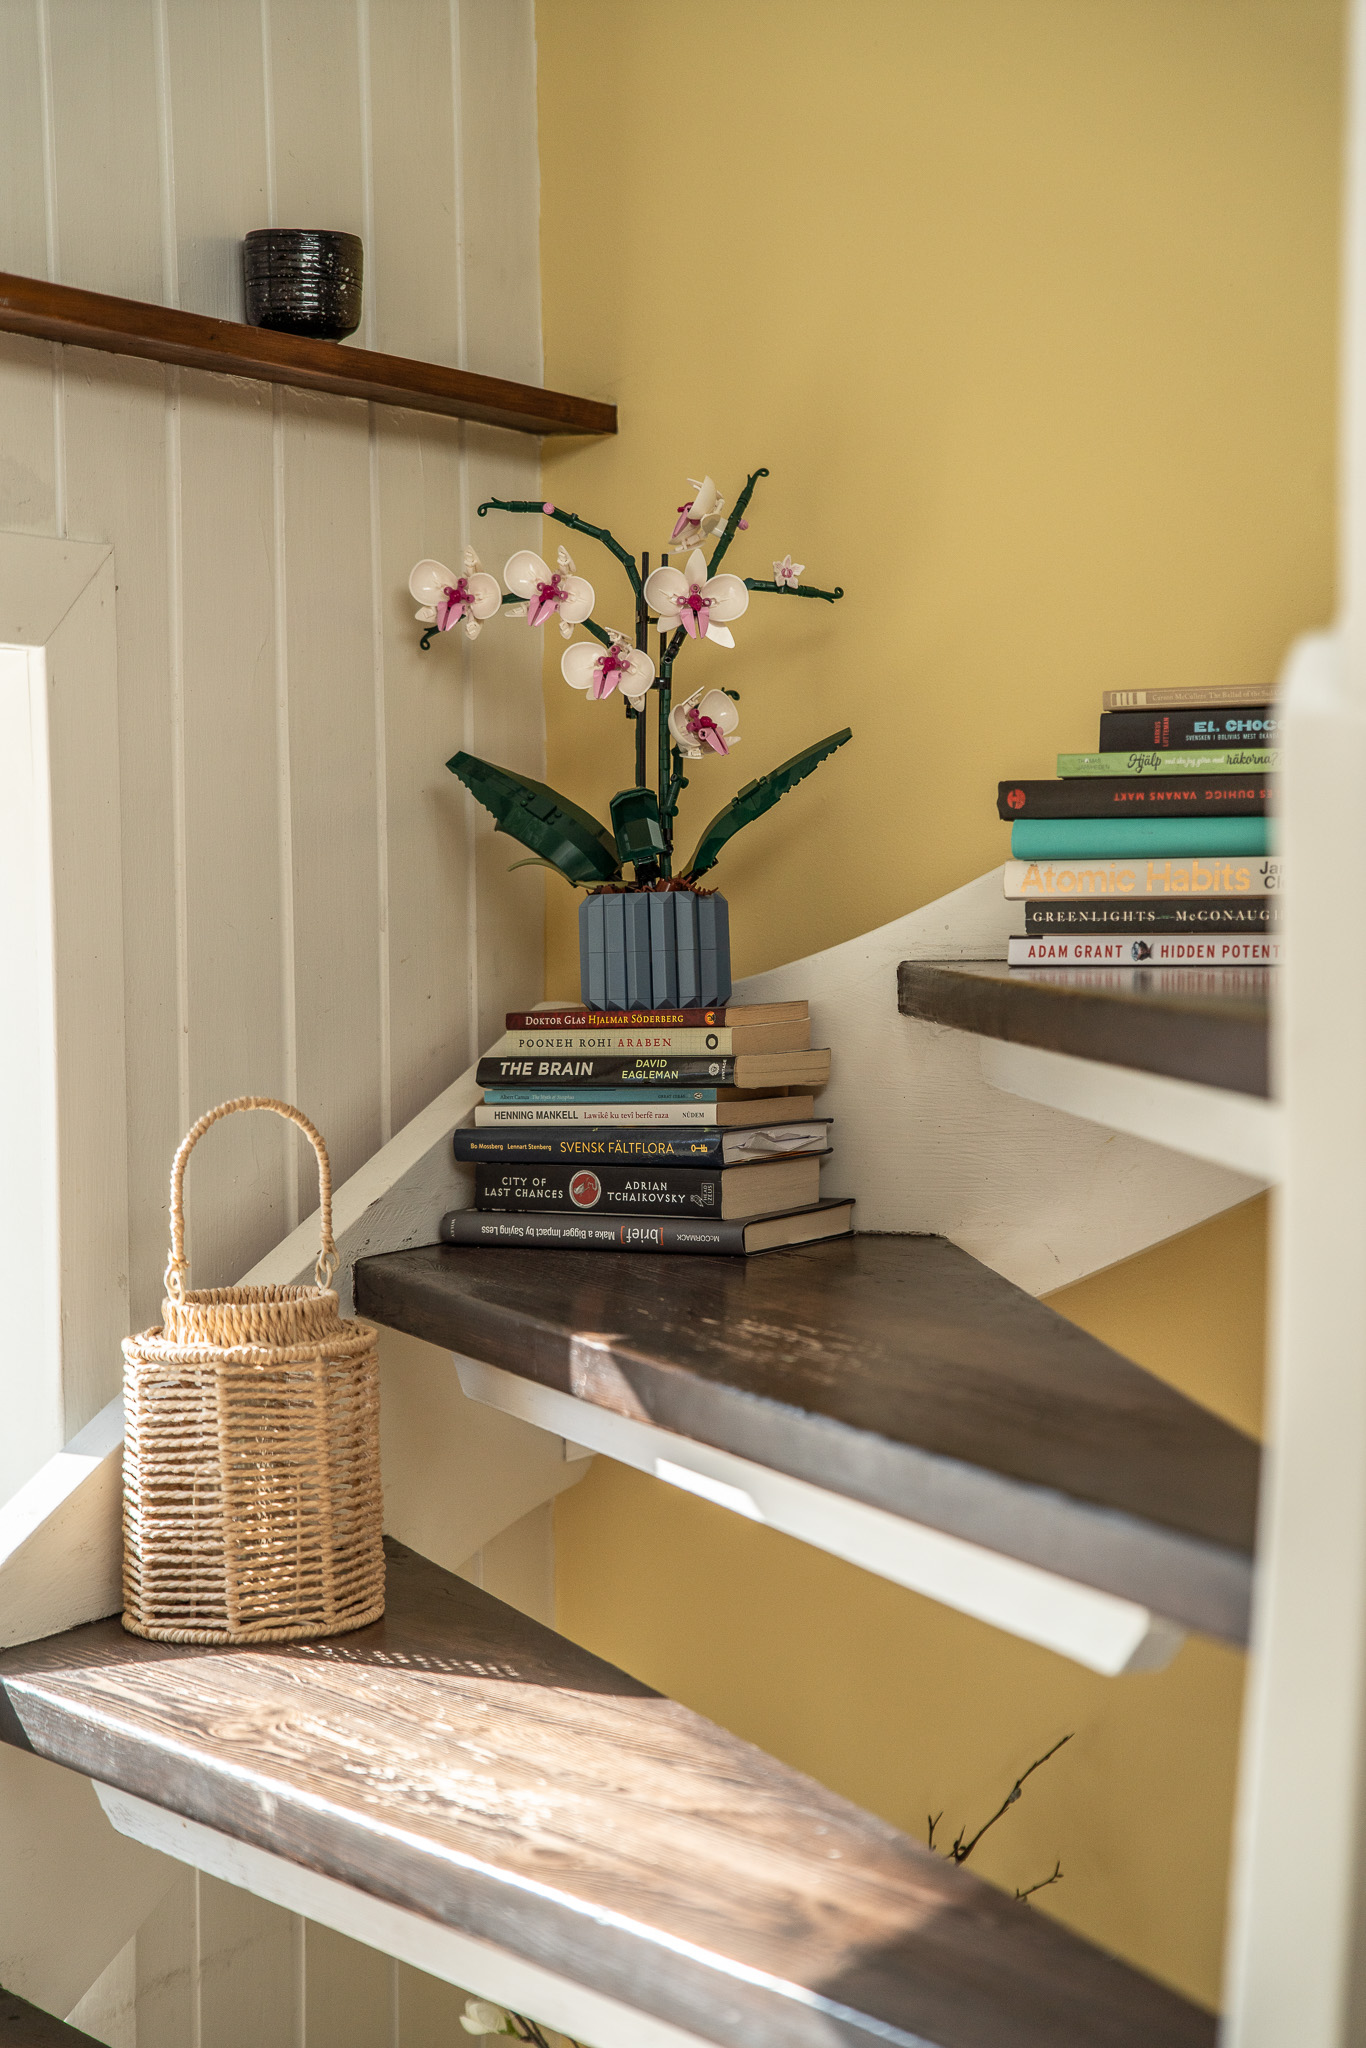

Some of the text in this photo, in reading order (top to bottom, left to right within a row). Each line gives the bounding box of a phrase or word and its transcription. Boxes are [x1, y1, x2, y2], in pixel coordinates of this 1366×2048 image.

[1127, 752, 1162, 773] Hjälp
[1114, 792, 1144, 801] MAKT
[1149, 791, 1197, 801] VANANS
[1204, 790, 1254, 800] DUHIGG
[1020, 860, 1251, 893] Atomic Habits
[1032, 911, 1156, 922] GREENLIGHTS
[1028, 944, 1286, 958] ADAM GRANT HIDDEN POTENT
[519, 1038, 672, 1048] POONEH ROHI ARABEN
[636, 1059, 667, 1068] DAVID
[500, 1062, 593, 1076] THE BRAIN
[621, 1070, 679, 1080] EAGLEMAN
[494, 1111, 534, 1120] HENNING
[536, 1110, 578, 1120] MANKELL
[608, 1111, 620, 1119] ku
[560, 1140, 674, 1154] SVENSK FÄLTFLORA
[501, 1177, 547, 1187] CITY OF
[625, 1181, 668, 1191] ADRIAN
[484, 1187, 564, 1199] LAST CHANCES
[607, 1192, 686, 1203] TCHAIKOVSKY
[481, 1225, 499, 1235] Less
[500, 1225, 524, 1237] Saying
[525, 1226, 535, 1237] by
[536, 1228, 561, 1238] Impact
[563, 1228, 587, 1239] Bigger
[594, 1230, 615, 1240] Make
